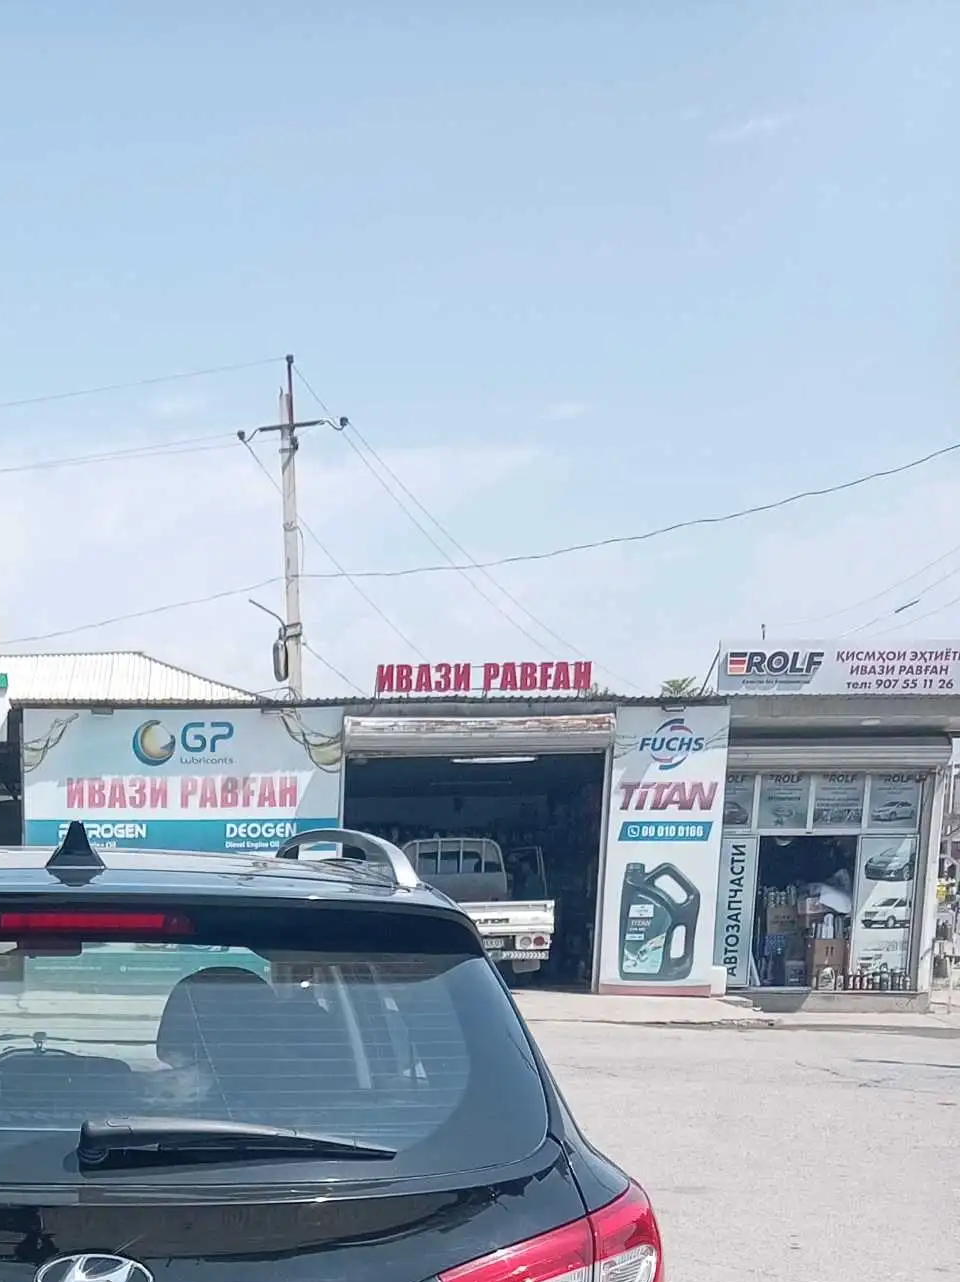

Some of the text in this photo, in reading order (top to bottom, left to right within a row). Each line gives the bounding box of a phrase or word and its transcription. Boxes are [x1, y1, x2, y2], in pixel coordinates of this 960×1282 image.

[836, 648, 960, 663] ҚИСМҲОИ ЭҲТИЁТ
[376, 661, 593, 693] ИВАЗИ РАВҒАН
[849, 665, 949, 676] ИВАЗИ РАВҒАН
[875, 679, 899, 689] 907
[901, 679, 918, 689] 55
[923, 679, 934, 689] 11
[938, 679, 954, 689] 26
[181, 722, 234, 753] GP
[639, 737, 705, 752] FUCHS
[66, 776, 298, 809] ИВАЗИ РАВҒАН
[226, 823, 297, 838] DEOGEN
[225, 840, 245, 849] Diesel
[246, 840, 269, 850] Engine
[725, 844, 746, 976] АВТОЗАПЧАСТИ
